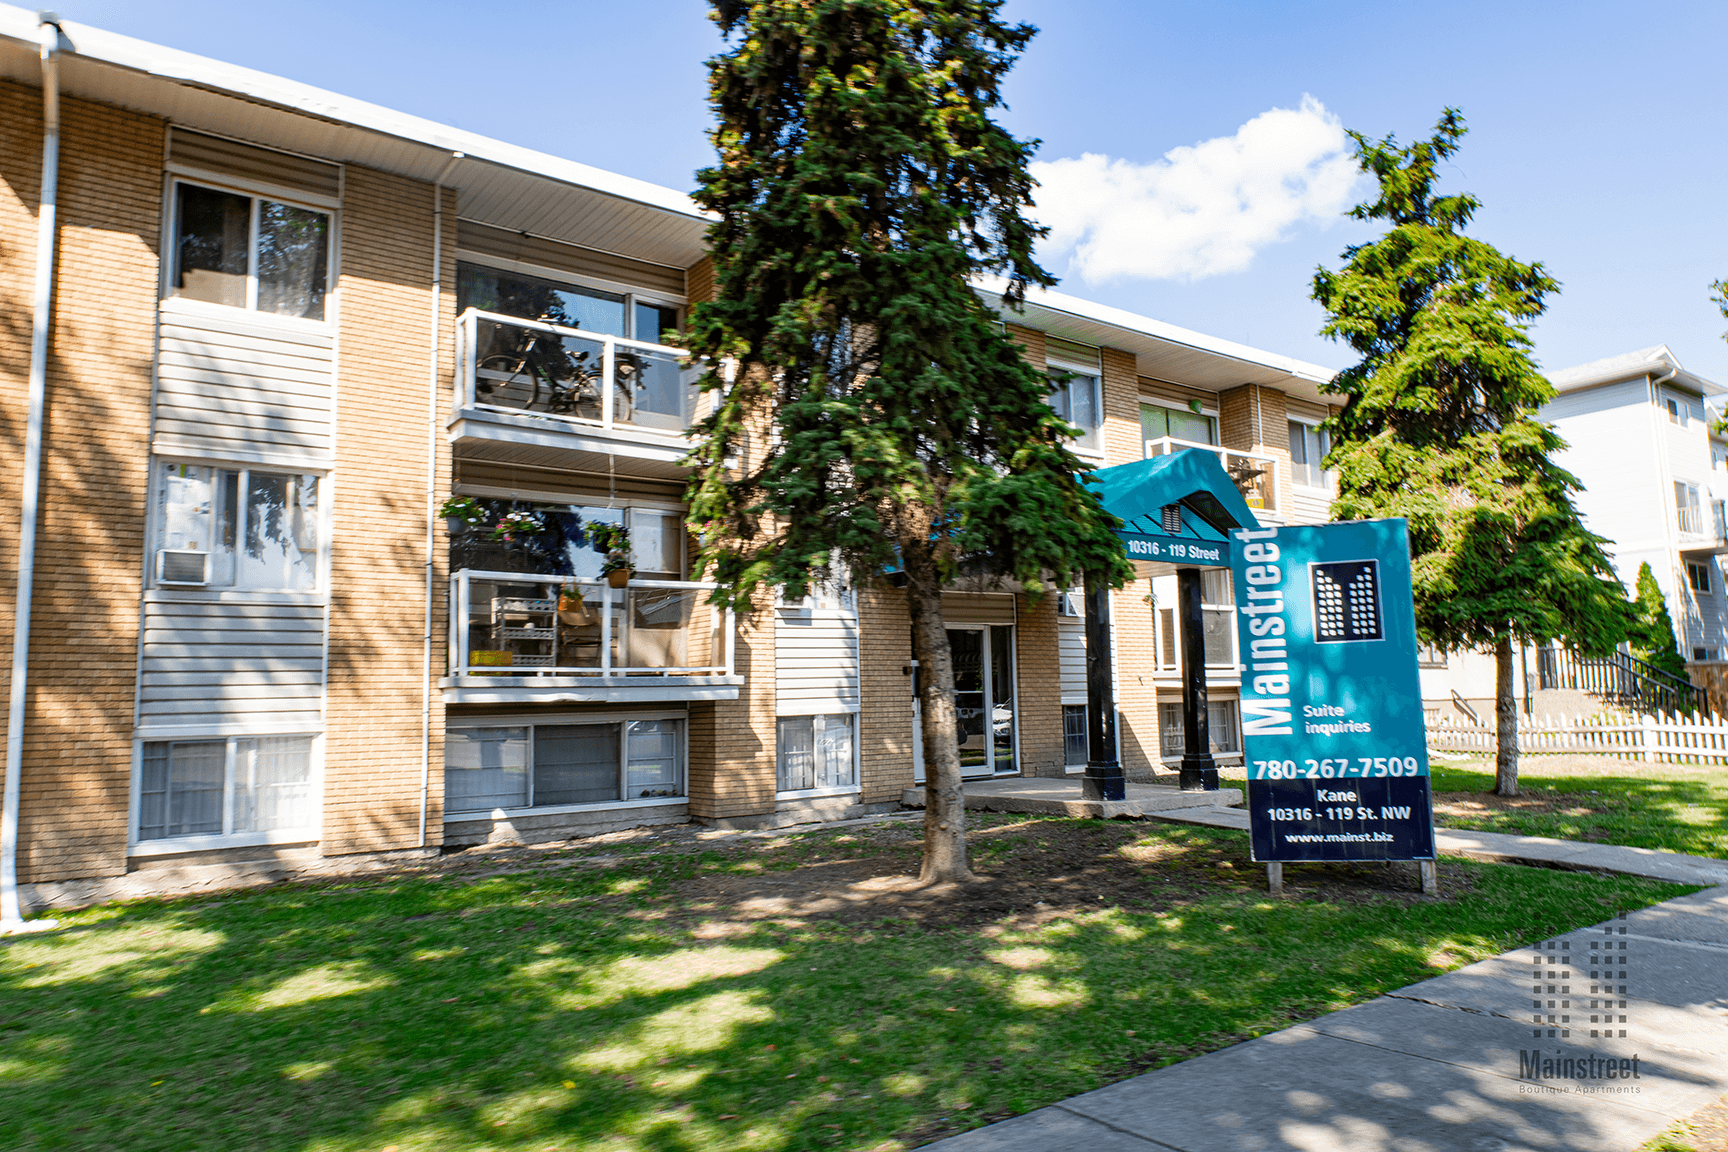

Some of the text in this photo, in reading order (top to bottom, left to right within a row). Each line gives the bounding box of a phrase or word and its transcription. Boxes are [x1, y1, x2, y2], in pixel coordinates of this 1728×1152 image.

[1128, 540, 1160, 555] 10316
[1168, 544, 1186, 557] 119
[1188, 545, 1220, 561] Street
[1234, 527, 1293, 736] Mainstreet
[1303, 704, 1345, 718] Suite
[1305, 720, 1371, 737] inquiries
[1253, 757, 1418, 780] 780-267-7509
[1316, 789, 1357, 802] Kane
[1267, 808, 1313, 821] 10316
[1325, 807, 1354, 820] 119
[1356, 806, 1378, 820] St.
[1381, 806, 1411, 820] NW
[1285, 831, 1394, 843] www.mainst.biz
